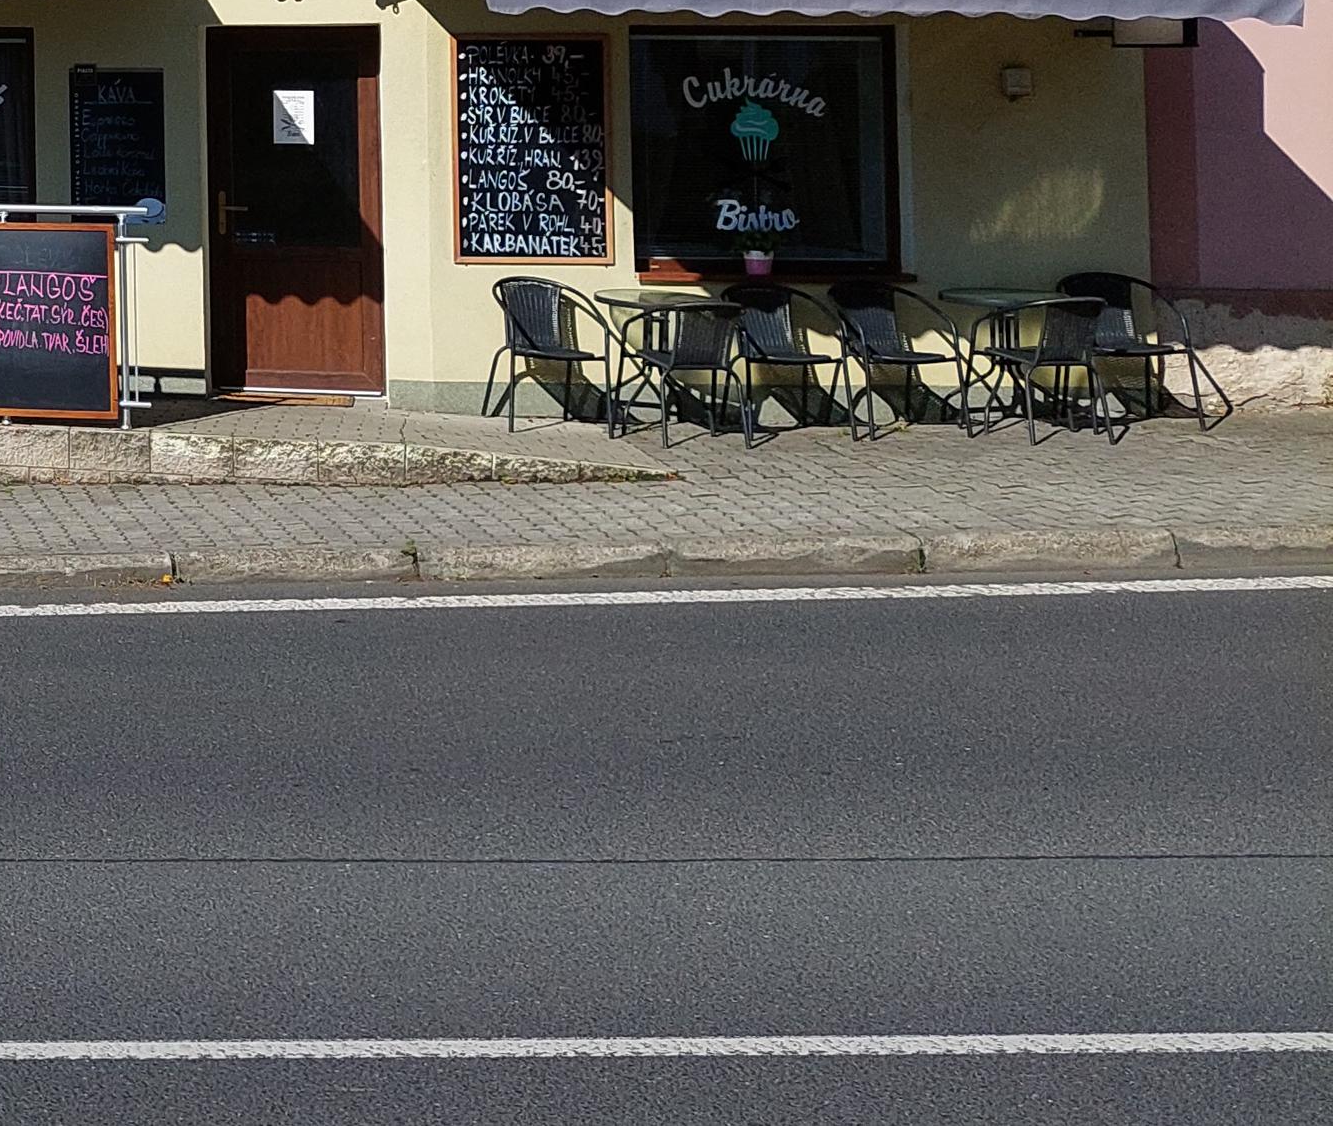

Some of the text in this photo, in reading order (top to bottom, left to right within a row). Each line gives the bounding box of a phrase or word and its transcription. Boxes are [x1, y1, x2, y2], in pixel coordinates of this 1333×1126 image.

[97, 78, 137, 103] KÁVA
[468, 85, 536, 105] KROKETY
[683, 67, 827, 117] Cukrárna
[496, 106, 506, 123] V
[510, 105, 552, 124] BULCE
[539, 126, 580, 144] BULCE
[468, 168, 531, 190] LANGOŠ
[471, 189, 564, 212] KLOBÁSA
[469, 211, 515, 232] PÁREK
[523, 214, 533, 231] V
[716, 199, 800, 232] Bistro
[471, 231, 581, 256] KARBANÁTEK
[3, 273, 97, 301] LANGOŠ
